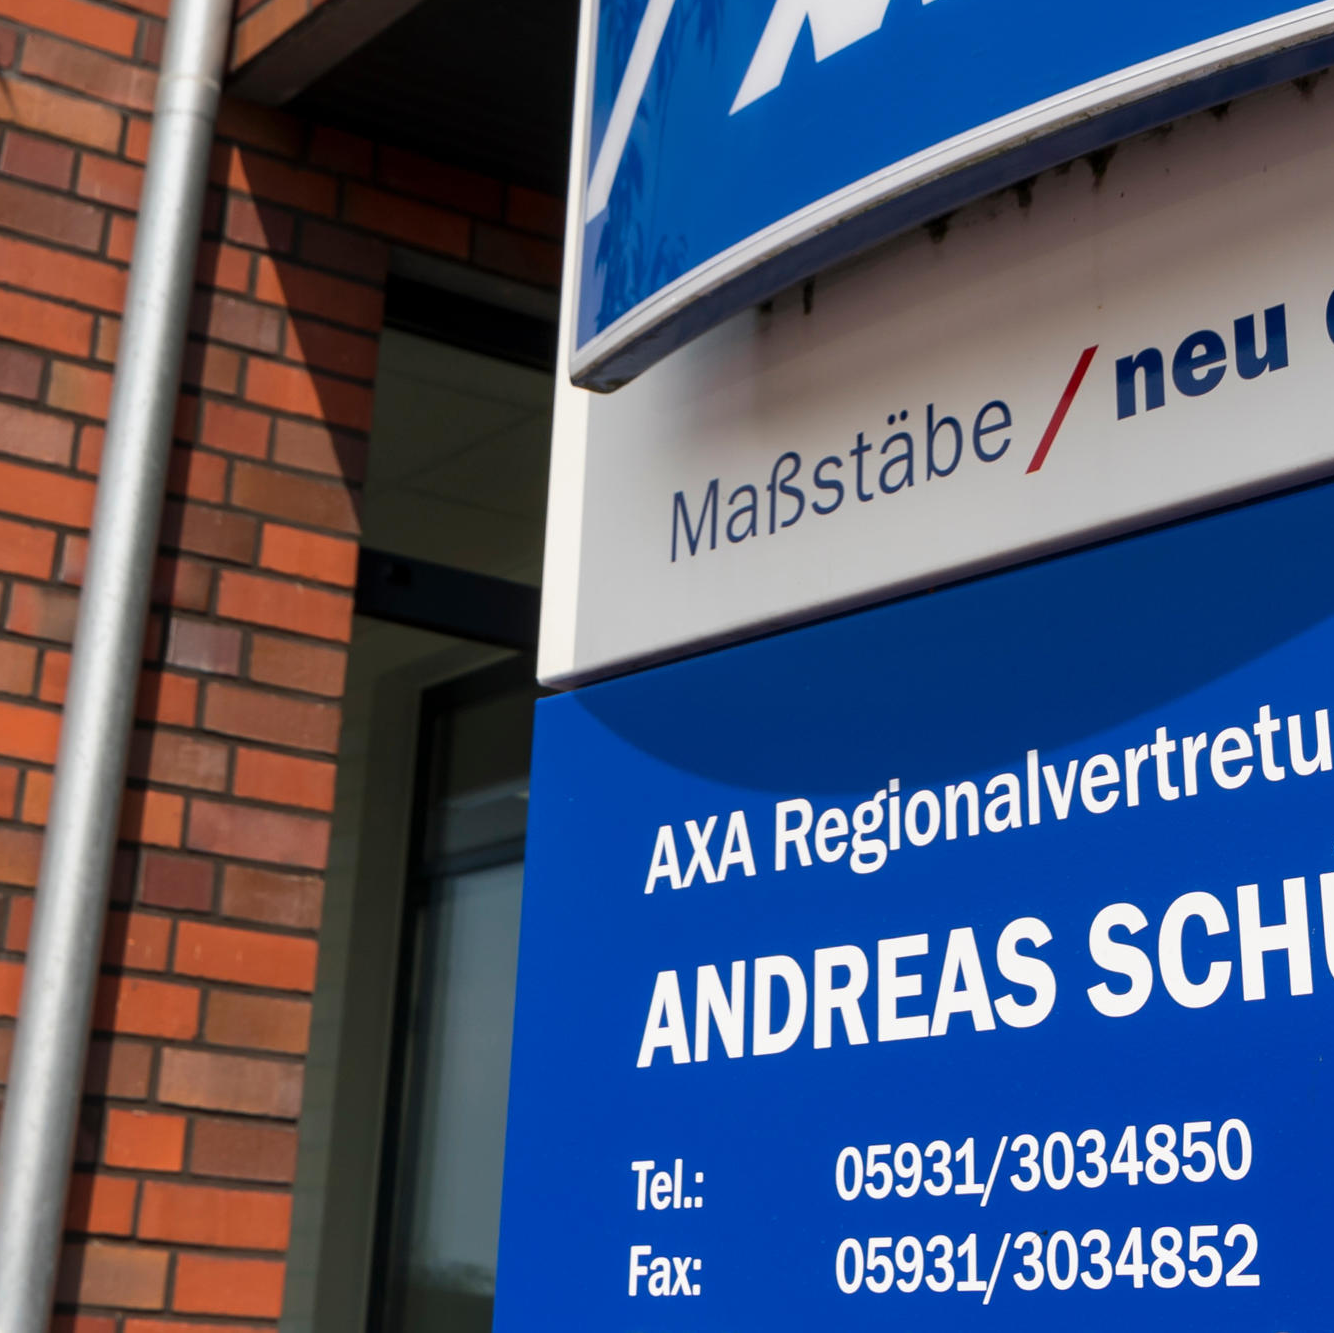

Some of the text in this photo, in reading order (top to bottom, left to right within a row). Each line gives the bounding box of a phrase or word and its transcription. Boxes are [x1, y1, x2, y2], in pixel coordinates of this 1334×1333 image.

[670, 398, 1013, 564] Maßstäbe
[1115, 303, 1290, 421] neu
[644, 809, 757, 895] AXA
[636, 916, 1057, 1069] ANDREAS
[630, 1118, 1254, 1211] Tel.: 05931/3034850
[627, 1223, 1261, 1306] Fax: 05931/3034852
